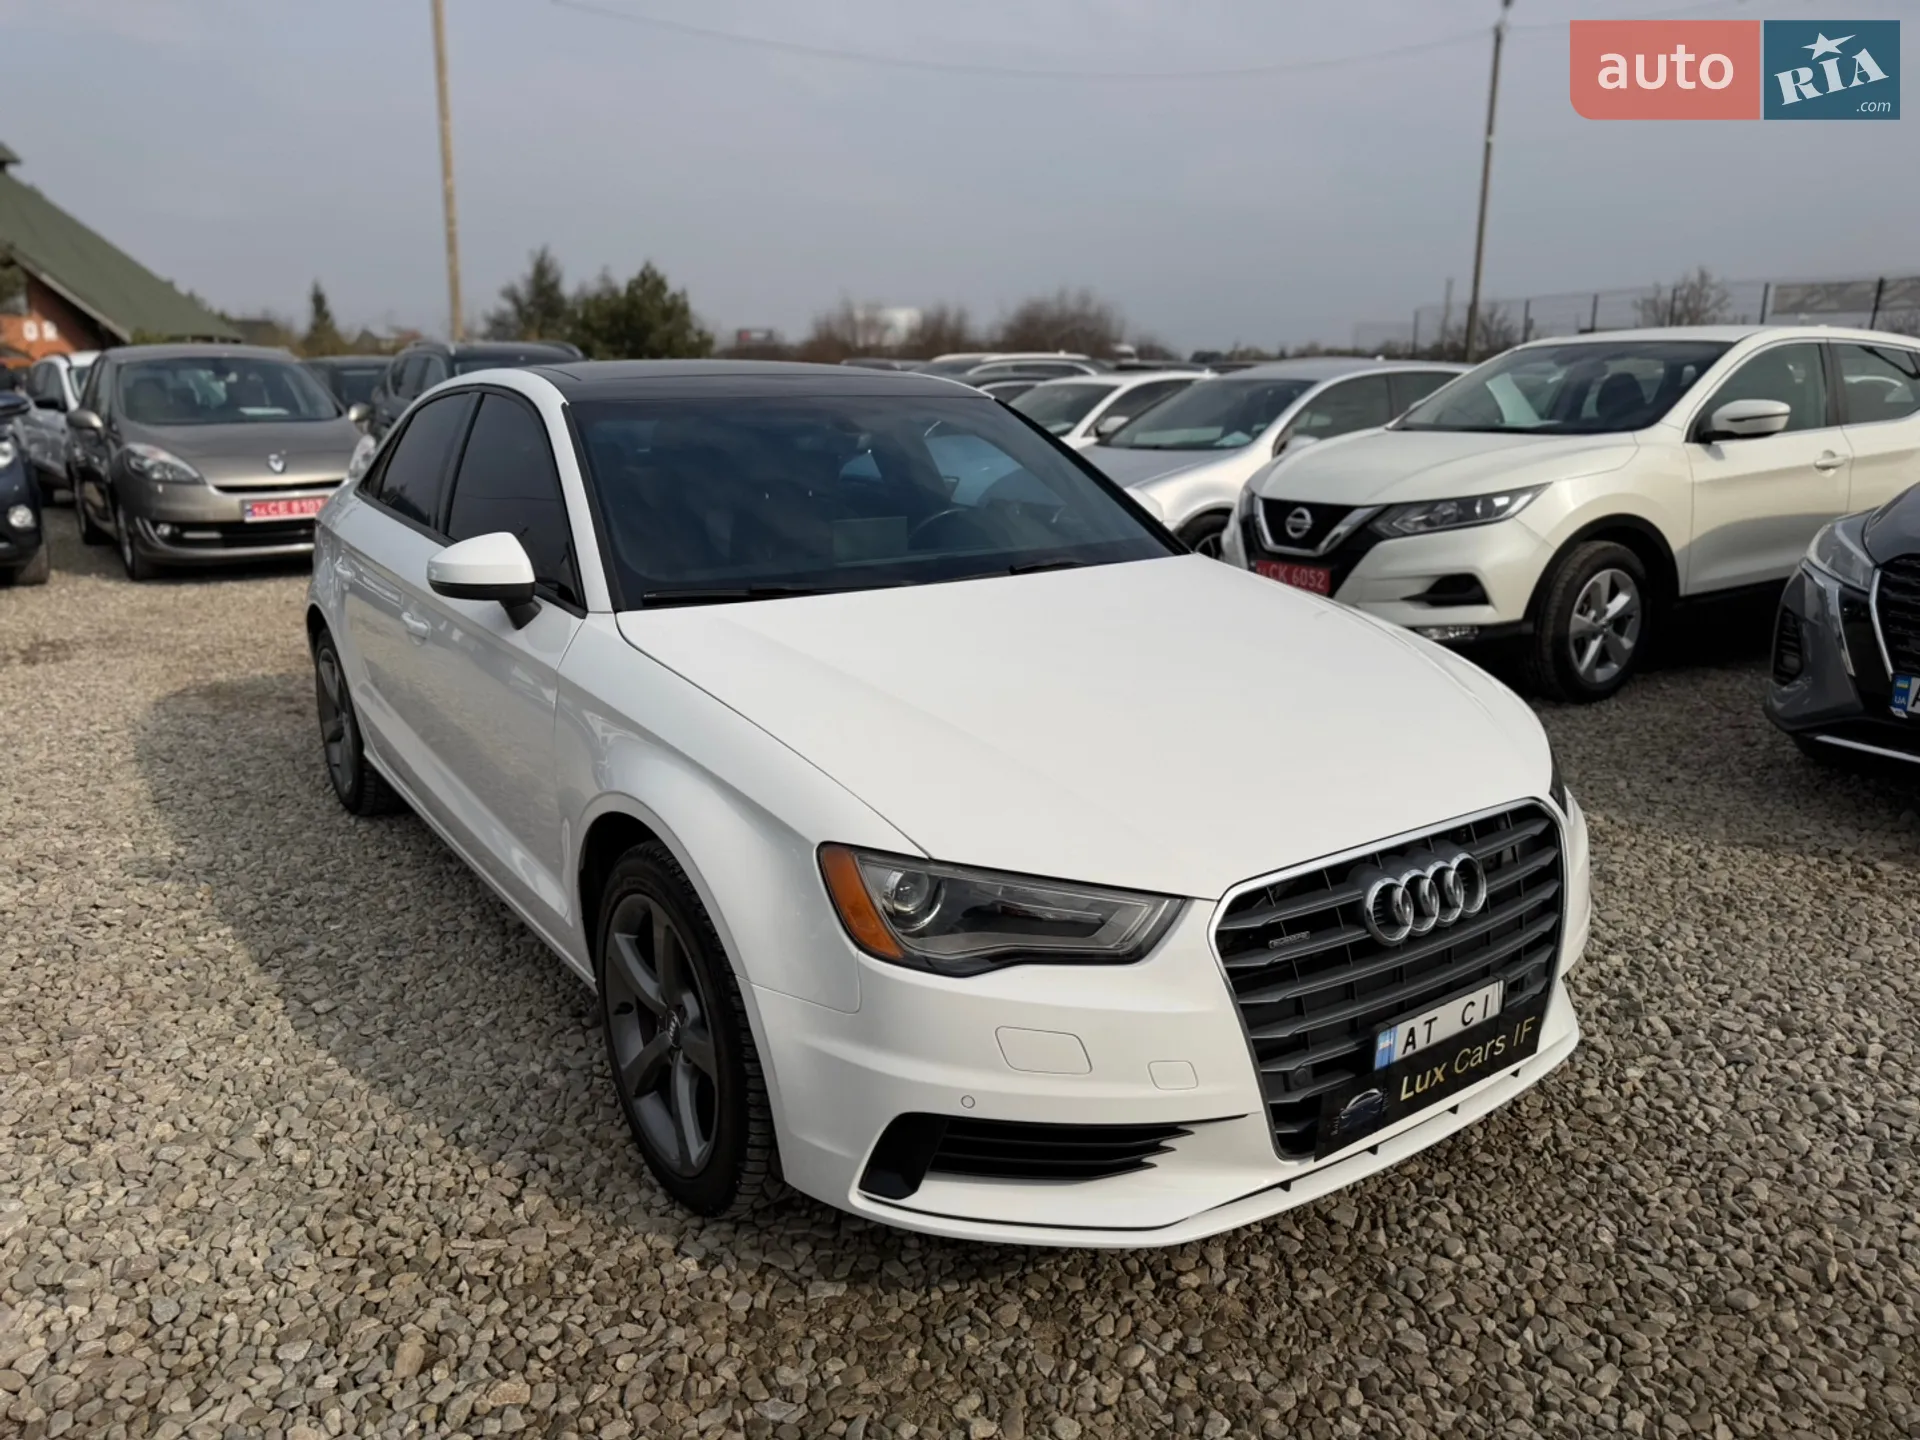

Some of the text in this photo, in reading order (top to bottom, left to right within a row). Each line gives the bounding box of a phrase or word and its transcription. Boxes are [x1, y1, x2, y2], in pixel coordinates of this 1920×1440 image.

[1292, 567, 1325, 589] 6052
[1402, 994, 1490, 1055] AT CI
[1400, 1062, 1448, 1101] Lux
[1454, 1033, 1507, 1075] Cars
[1512, 1016, 1536, 1047] IF
